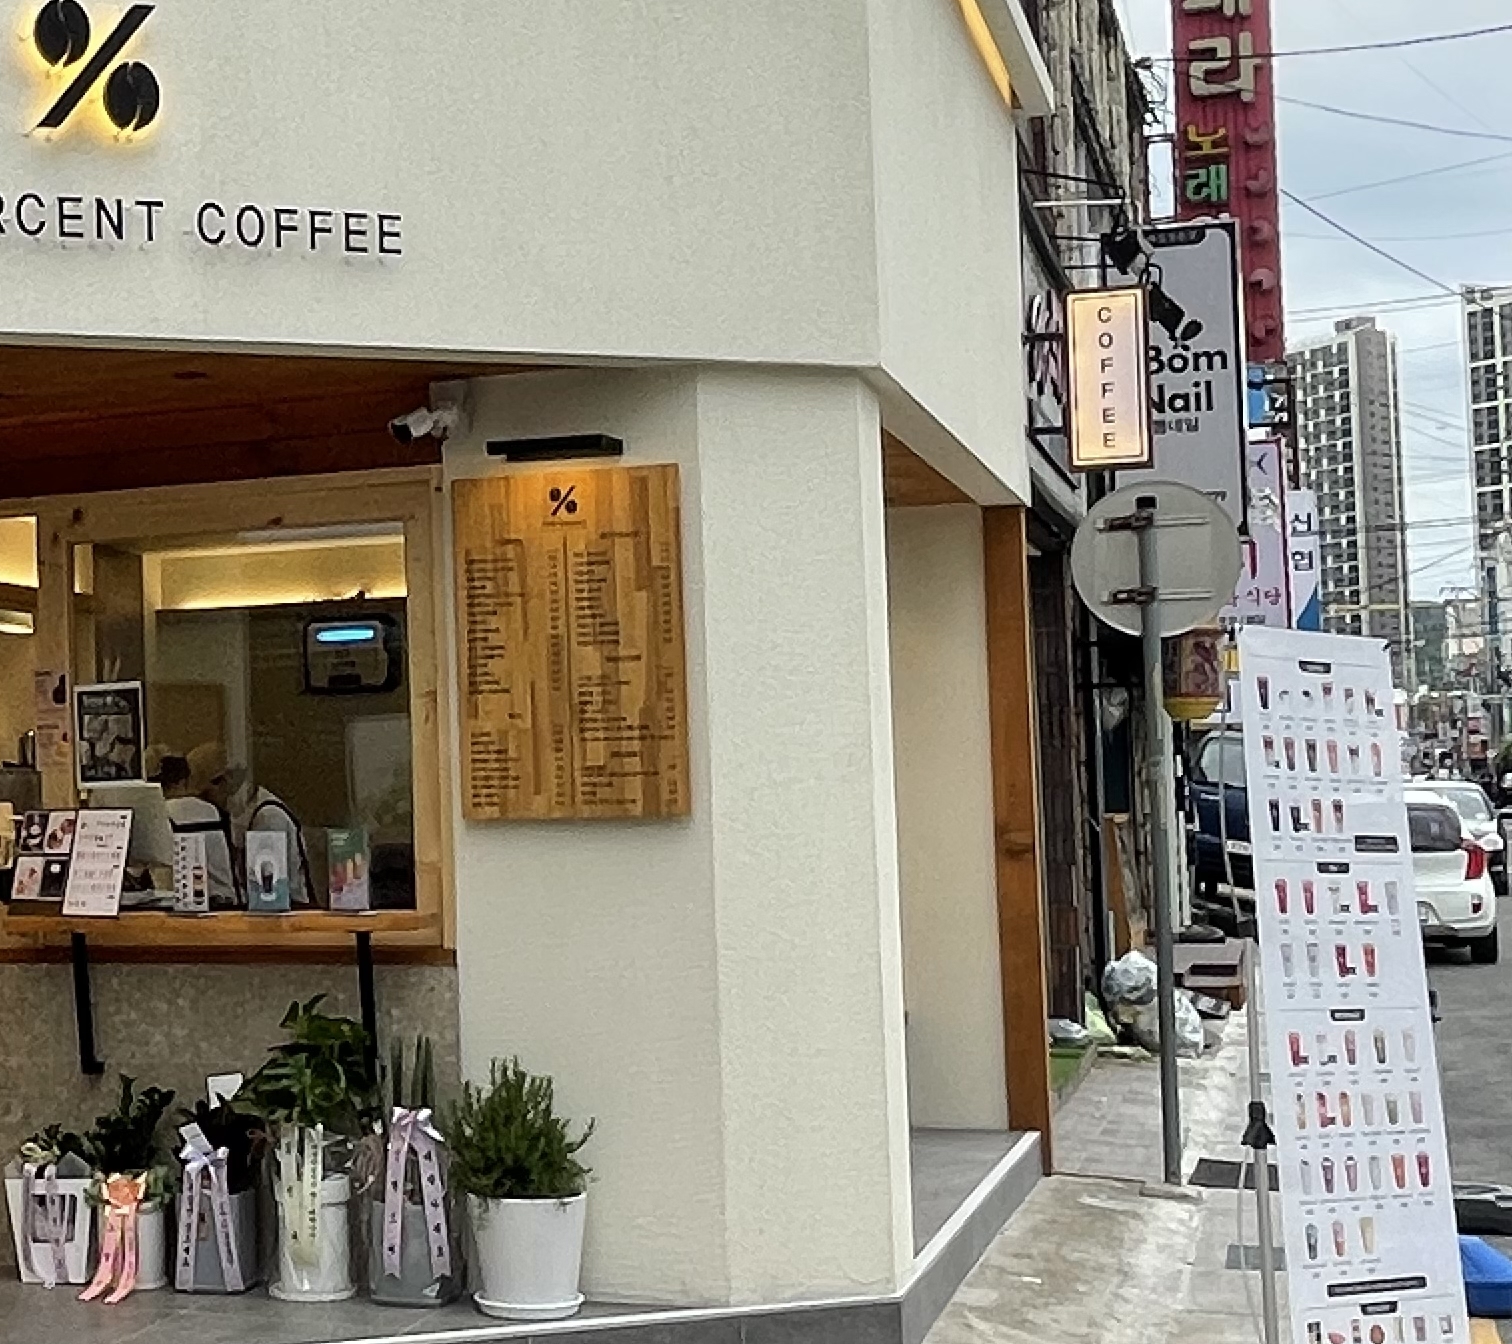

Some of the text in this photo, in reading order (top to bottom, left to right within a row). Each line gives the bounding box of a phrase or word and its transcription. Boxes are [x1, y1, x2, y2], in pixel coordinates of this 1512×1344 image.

[1184, 124, 1230, 202] 노래
[196, 201, 403, 256] COFFEE
[1096, 306, 1116, 449] COFFEE
